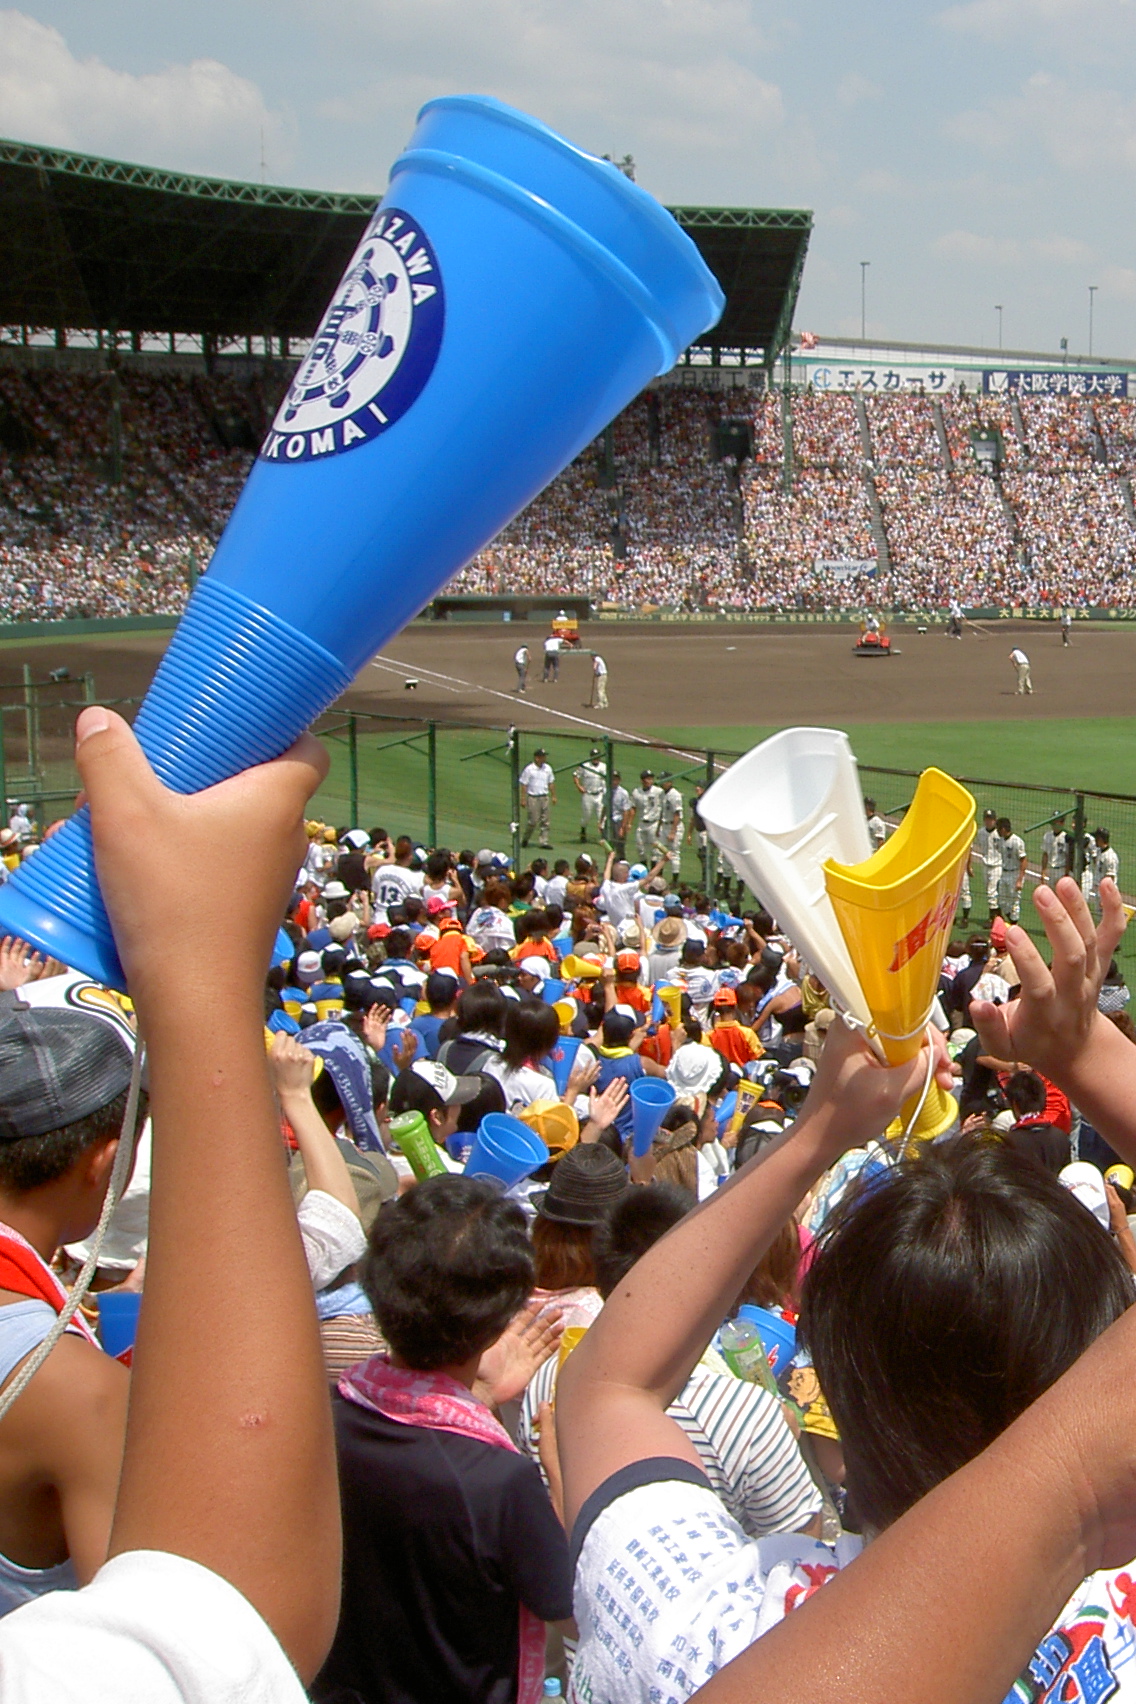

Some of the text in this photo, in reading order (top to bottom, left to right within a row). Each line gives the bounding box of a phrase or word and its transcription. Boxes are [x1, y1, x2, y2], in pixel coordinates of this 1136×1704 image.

[838, 370, 947, 391] エスカーサ
[1013, 373, 1124, 394] 大阪学院大学
